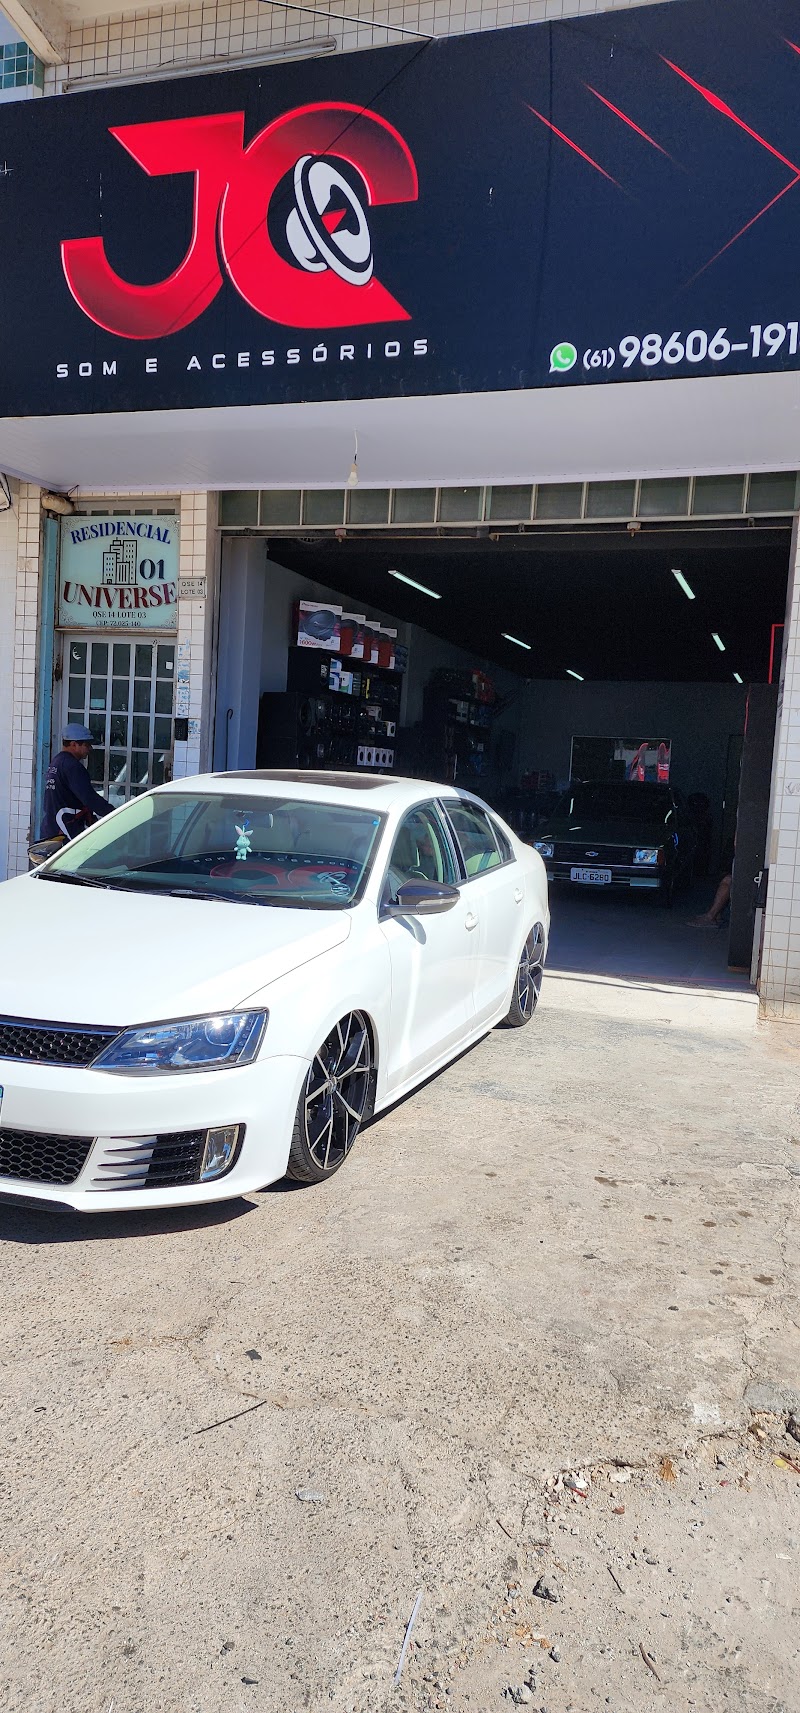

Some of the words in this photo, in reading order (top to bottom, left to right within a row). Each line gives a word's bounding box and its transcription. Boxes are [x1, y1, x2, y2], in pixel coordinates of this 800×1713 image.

[56, 360, 118, 378] SOM
[145, 357, 158, 373] E
[186, 338, 428, 371] ACESSÓRIOS
[582, 346, 616, 371] (61)
[618, 320, 800, 368] 98606-191
[70, 521, 171, 545] RESIDENCIAL
[139, 558, 165, 580] 01
[63, 580, 178, 610] UNIVERSE
[92, 610, 107, 619] QSE
